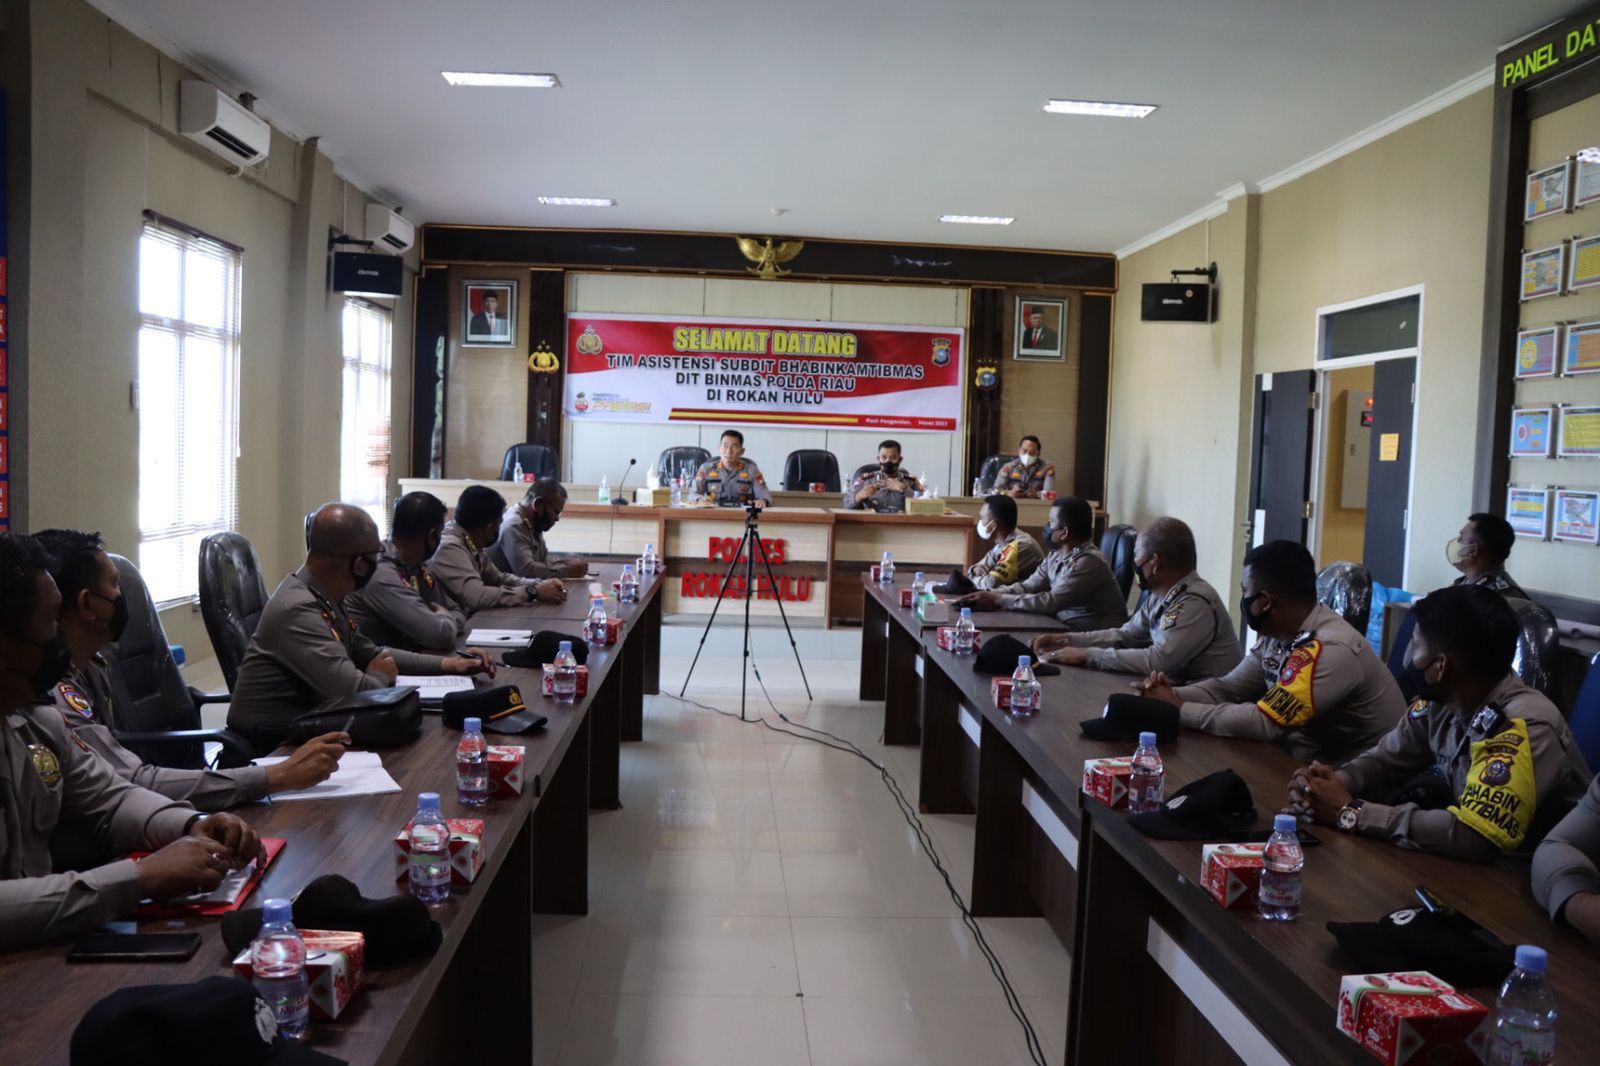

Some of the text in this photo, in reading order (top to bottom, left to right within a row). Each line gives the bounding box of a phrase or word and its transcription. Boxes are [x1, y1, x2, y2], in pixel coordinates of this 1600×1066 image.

[1503, 43, 1559, 88] PANEL
[674, 327, 857, 357] SELAMAT DATANG
[607, 354, 923, 379] TIM ASISTENSI SUBDIT BHABINKAMTIBMAS
[676, 372, 855, 391] DIT BINMAS POLDA RIAU
[707, 389, 823, 405] DI ROKAN HULU
[681, 571, 811, 602] ROKAN HULU
